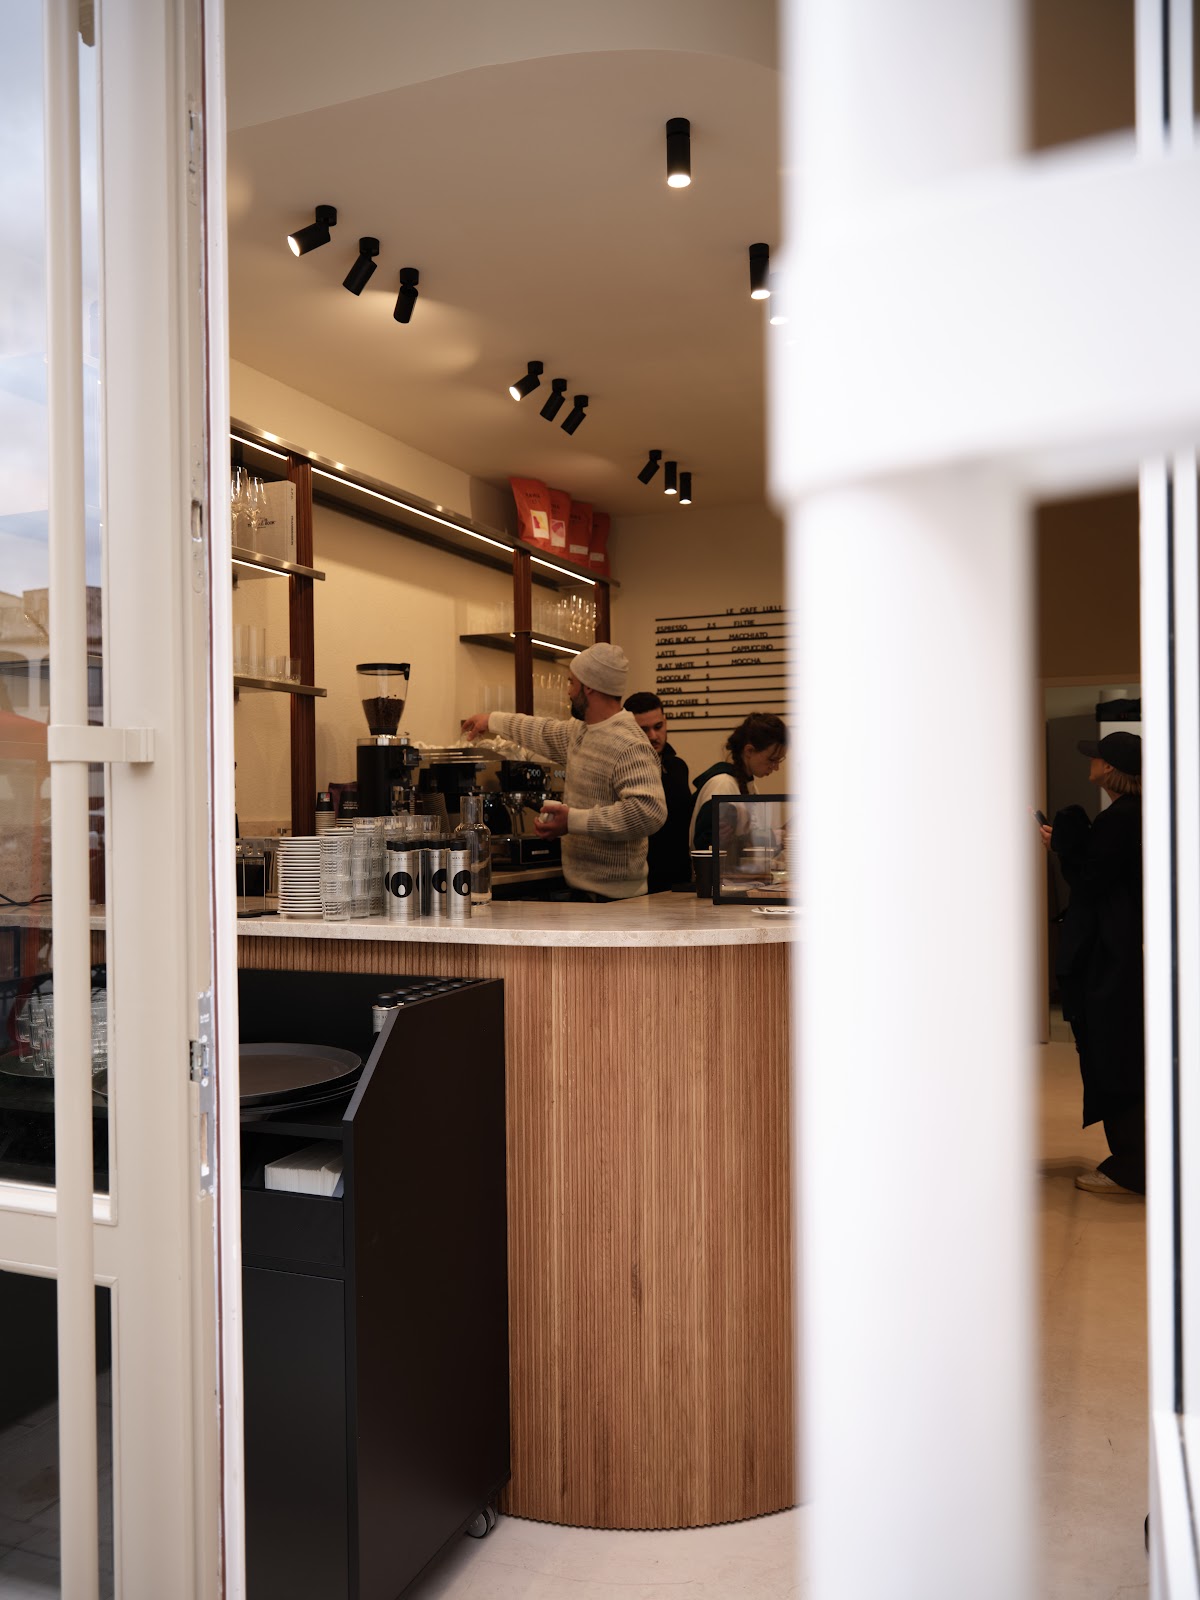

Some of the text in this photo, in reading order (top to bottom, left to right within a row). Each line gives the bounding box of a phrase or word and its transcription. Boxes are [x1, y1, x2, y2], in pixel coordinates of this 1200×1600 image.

[656, 624, 688, 632] ESPRESSO
[728, 632, 768, 640] MACCHIATO
[732, 644, 774, 652] CAPPUCCINO
[656, 674, 691, 682] CHOCOLAT
